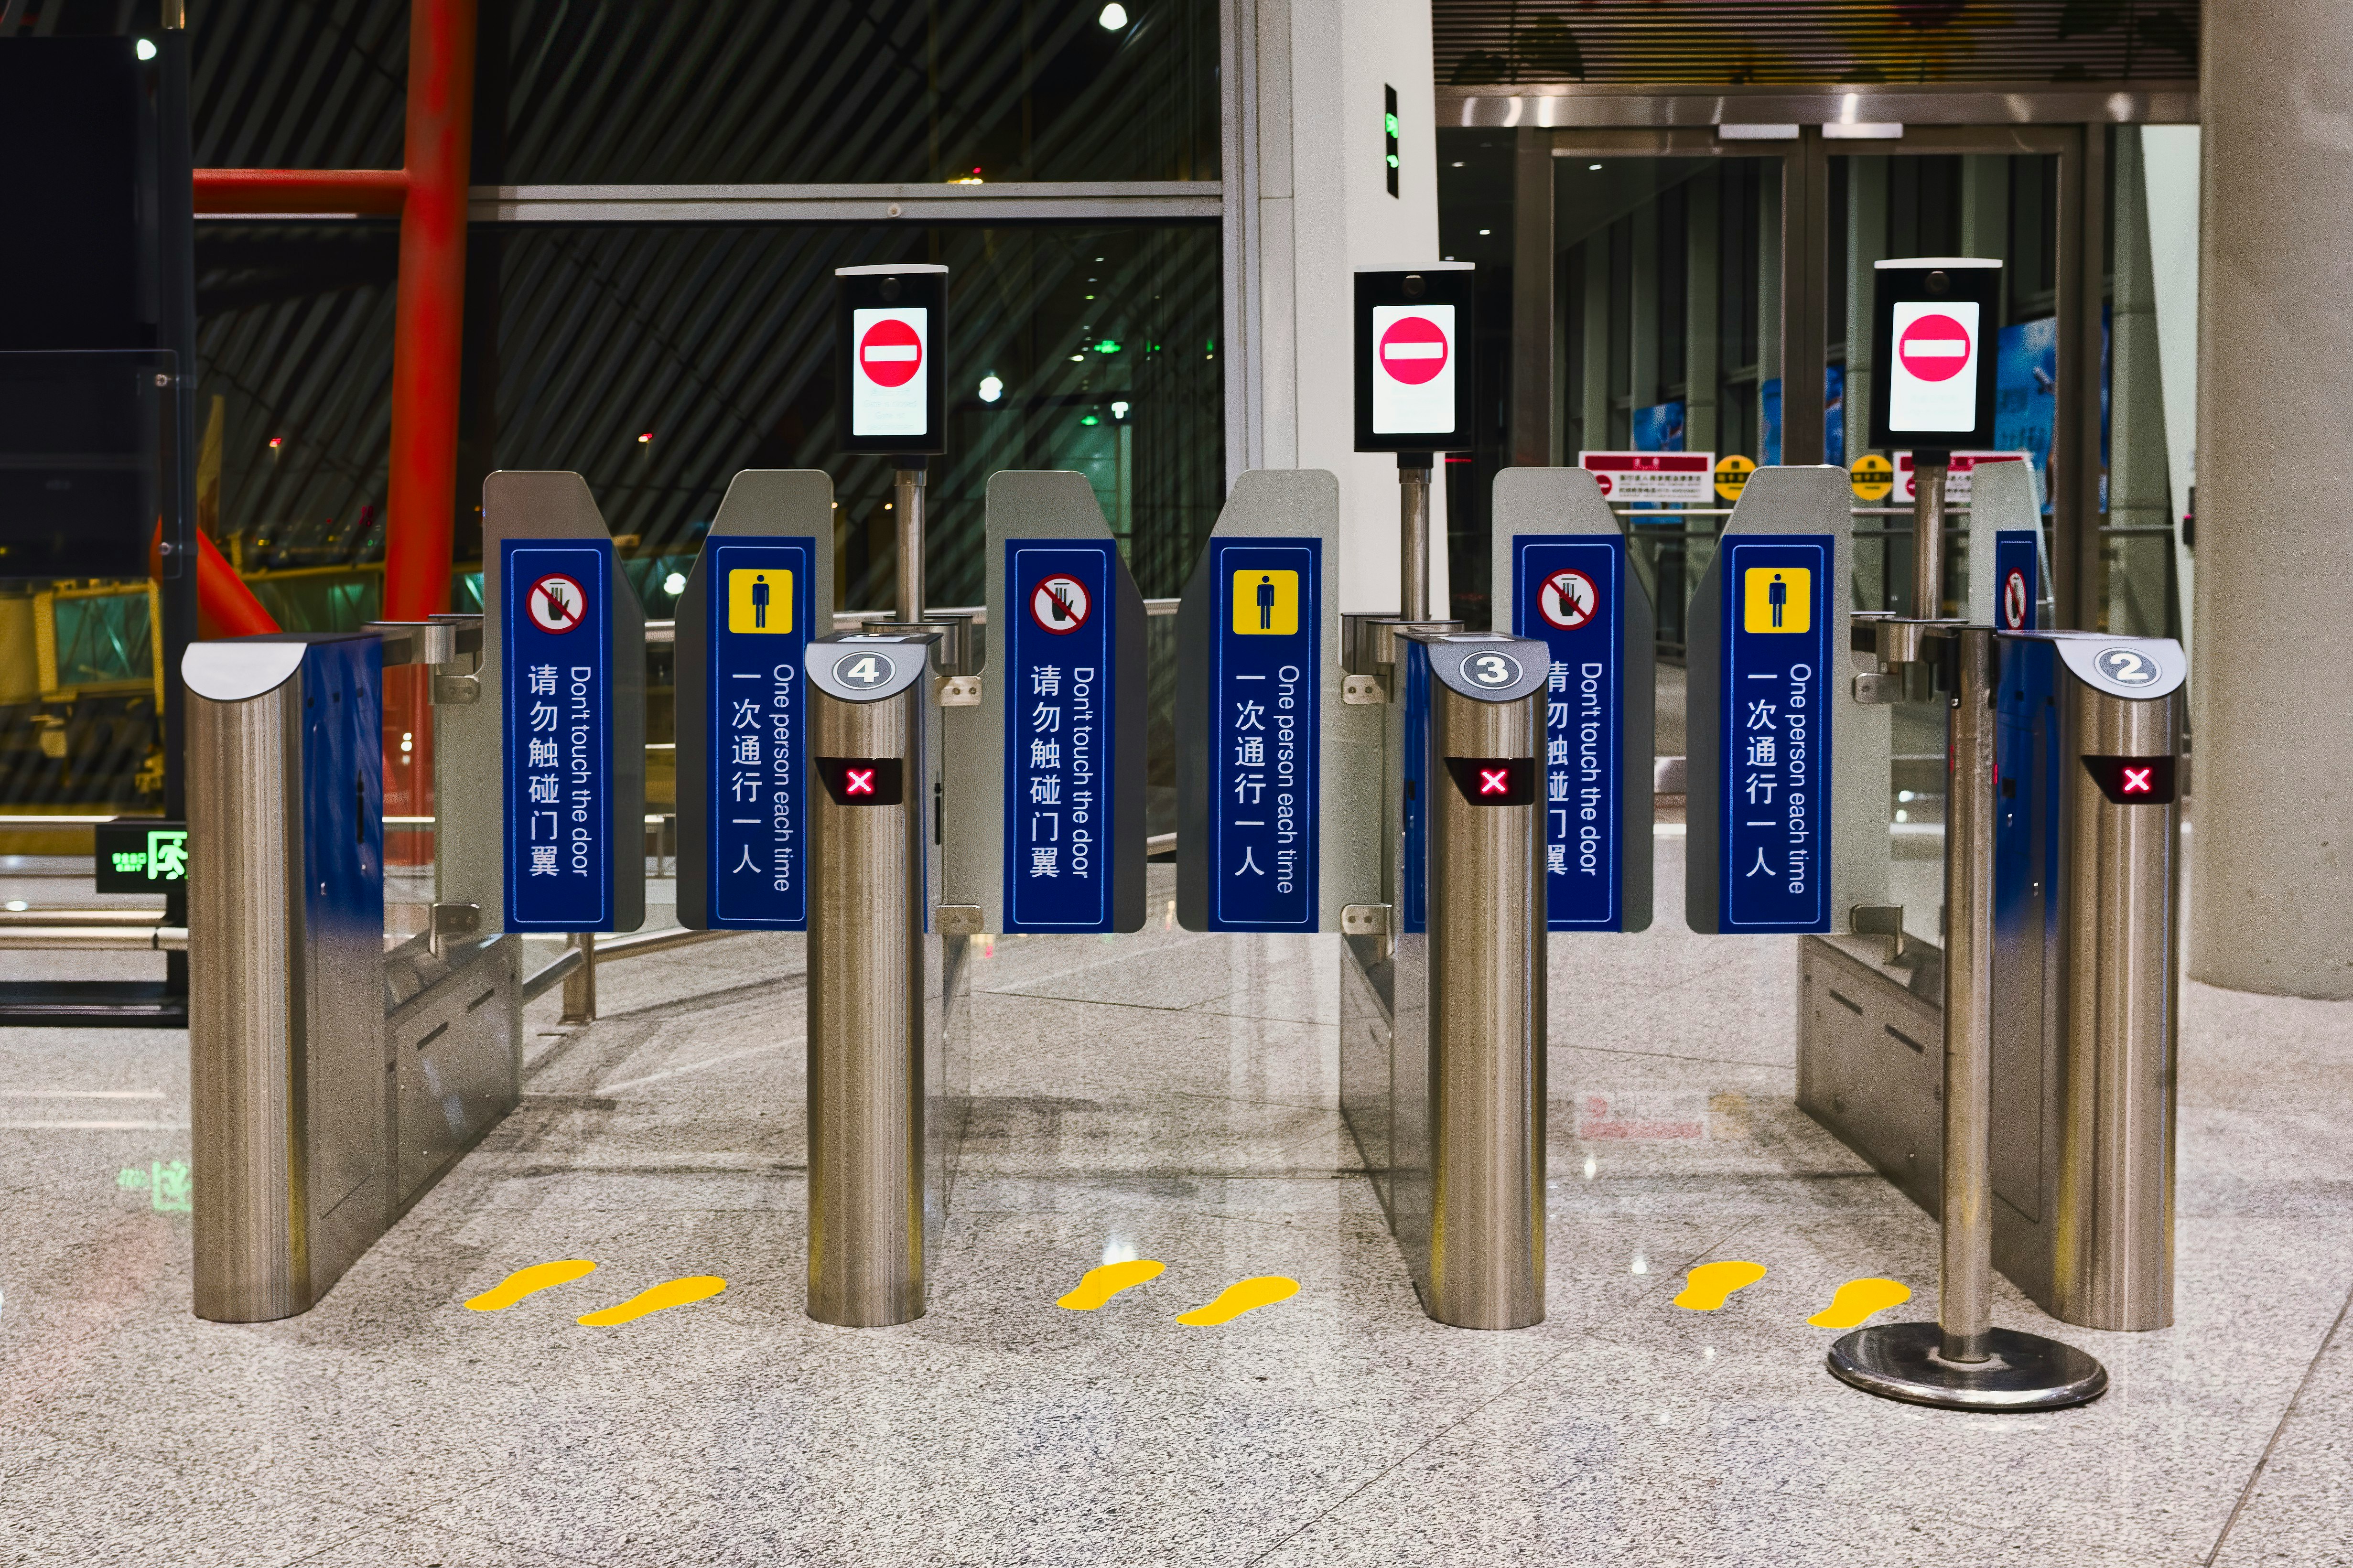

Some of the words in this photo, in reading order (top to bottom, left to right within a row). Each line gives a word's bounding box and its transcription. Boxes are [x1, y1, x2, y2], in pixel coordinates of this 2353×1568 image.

[774, 664, 794, 708] One
[847, 657, 879, 683] 4
[1278, 665, 1300, 709] One
[1476, 656, 1509, 683] 3
[1581, 663, 1602, 717] Don't
[1790, 664, 1812, 708] One
[2109, 653, 2149, 680] 2
[571, 666, 591, 720] Don't
[1074, 667, 1094, 721] Don't
[528, 664, 560, 876] 请勿触碰门翼
[571, 724, 592, 784] touch
[732, 674, 763, 873] 一次通行一人
[769, 714, 789, 785] person
[1030, 665, 1061, 878] 请勿触碰门翼
[1073, 725, 1093, 784] touch
[1273, 715, 1294, 787] person
[1580, 721, 1601, 781] touch
[1785, 714, 1806, 786] person
[1234, 675, 1266, 876] 一次通行一人
[1746, 674, 1778, 877] 一次通行一人
[572, 789, 592, 822] the
[774, 791, 794, 841] each
[1073, 790, 1093, 824] the
[1277, 793, 1298, 843] each
[1580, 787, 1601, 820] the
[1789, 793, 1809, 843] each
[572, 827, 592, 877] door
[774, 847, 794, 891] time
[1072, 829, 1093, 879] door
[1277, 849, 1298, 893] time
[1580, 826, 1601, 876] door
[1789, 849, 1809, 894] time
